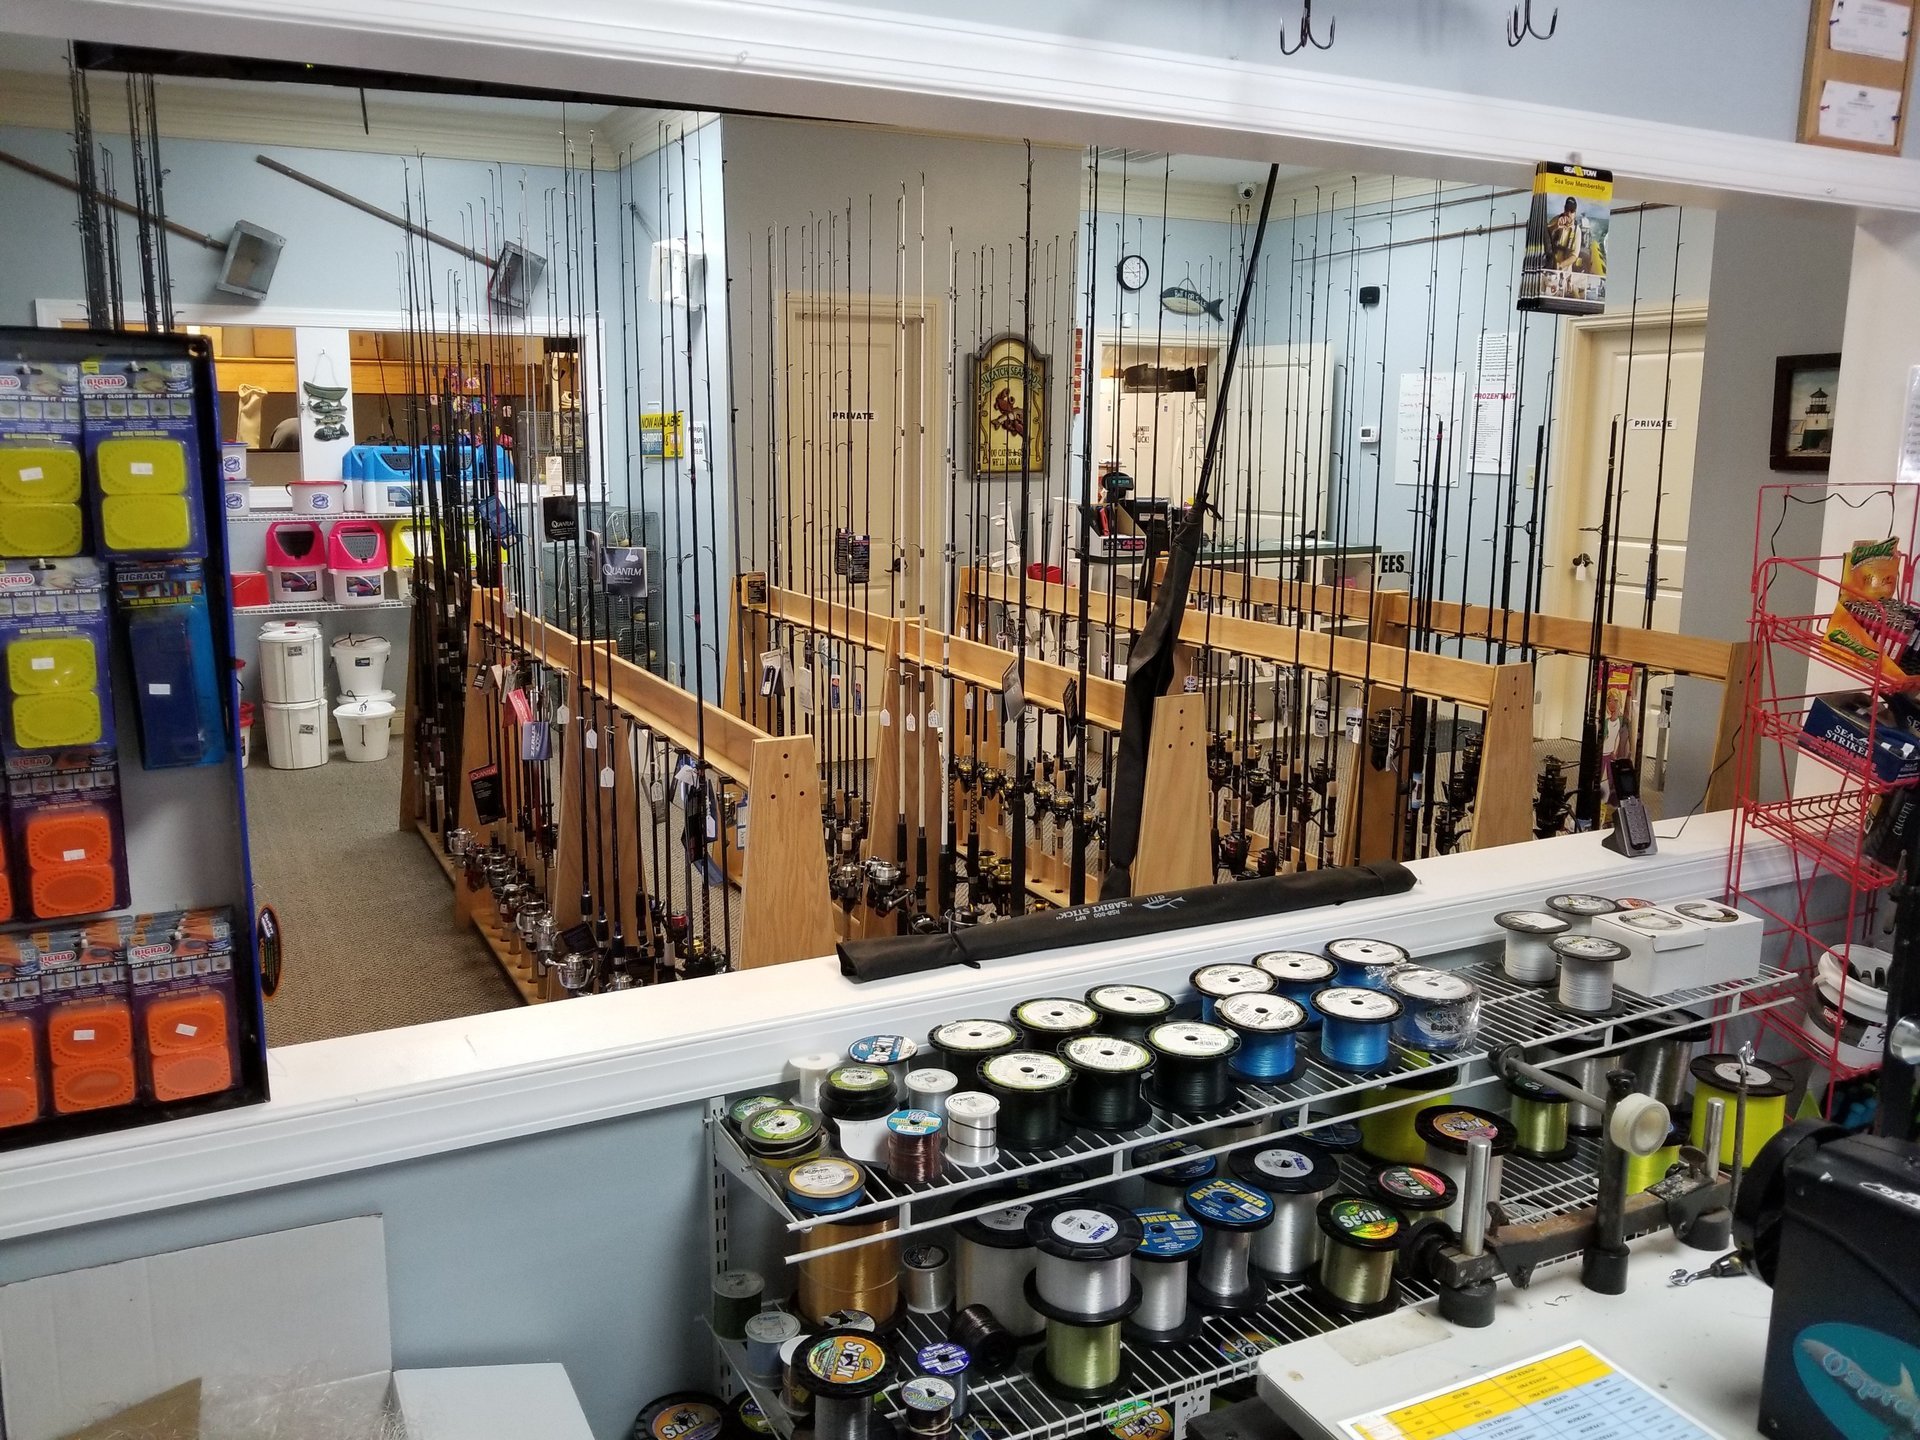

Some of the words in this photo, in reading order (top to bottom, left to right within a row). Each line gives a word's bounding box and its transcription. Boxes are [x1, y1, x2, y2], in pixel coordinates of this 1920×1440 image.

[1582, 168, 1597, 177] TOW
[1575, 180, 1605, 192] Membership
[1010, 366, 1038, 384] SEAOD
[87, 378, 124, 388] RIGRAP
[1474, 392, 1500, 400] FROZEN
[1500, 392, 1516, 400] BAIT
[641, 417, 653, 429] NOW
[653, 415, 681, 428] AVALABE
[602, 563, 643, 577] QUANTUM
[1379, 554, 1405, 573] EES
[117, 571, 166, 582] RIGRACK
[1834, 724, 1855, 741] SEA
[471, 767, 498, 781] QUANTUM
[134, 945, 170, 959] RIGRAP
[1391, 1171, 1431, 1196] Suix
[836, 1341, 867, 1379] Suix
